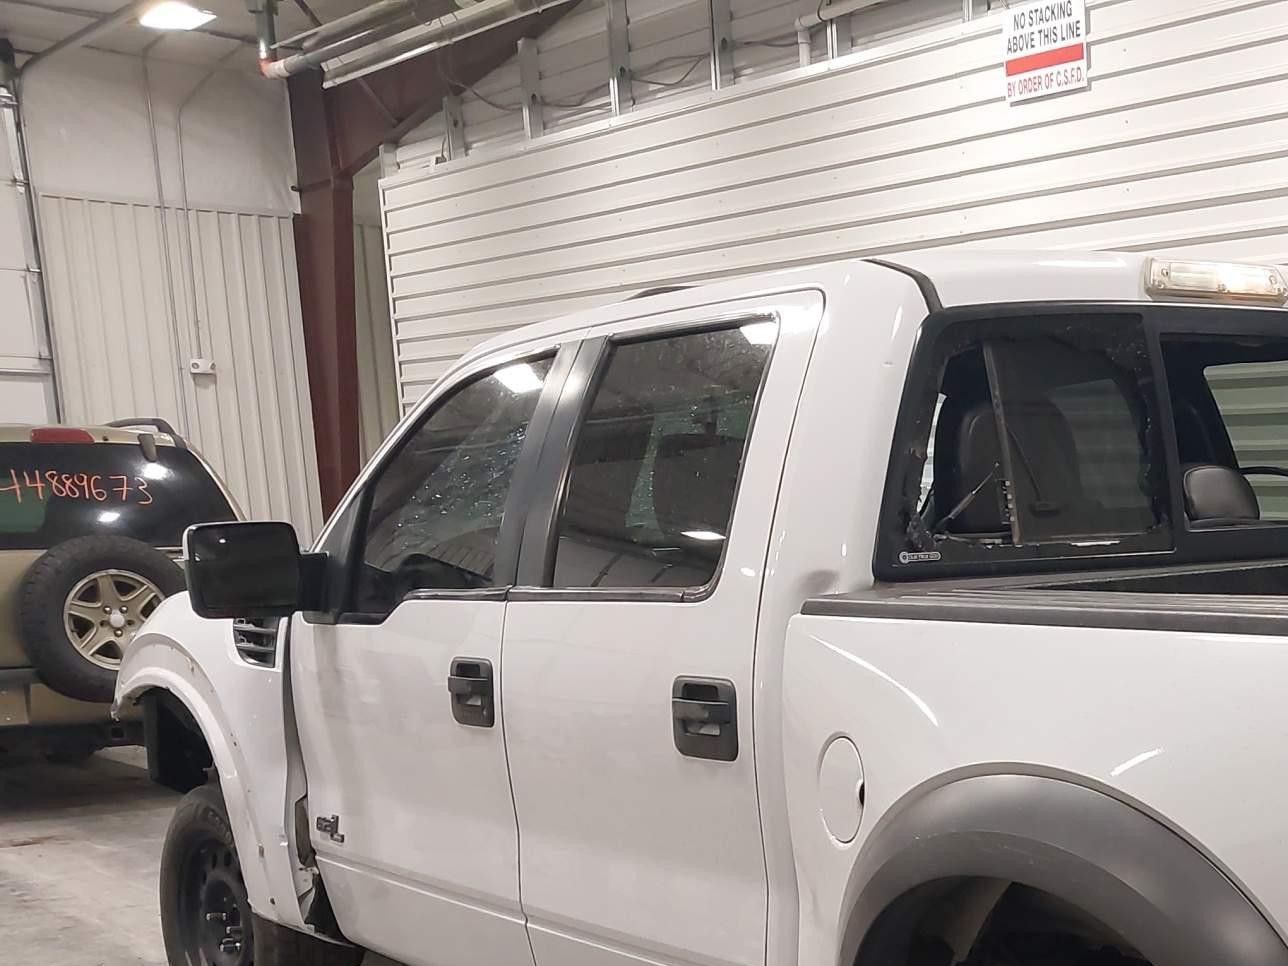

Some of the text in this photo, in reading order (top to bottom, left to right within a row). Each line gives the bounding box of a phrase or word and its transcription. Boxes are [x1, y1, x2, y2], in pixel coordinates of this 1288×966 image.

[1013, 0, 1072, 32] NO STACKING
[1007, 20, 1081, 55] ABOVE THIS LINE
[1007, 66, 1085, 98] BY ORDER OF C.S.F.D.
